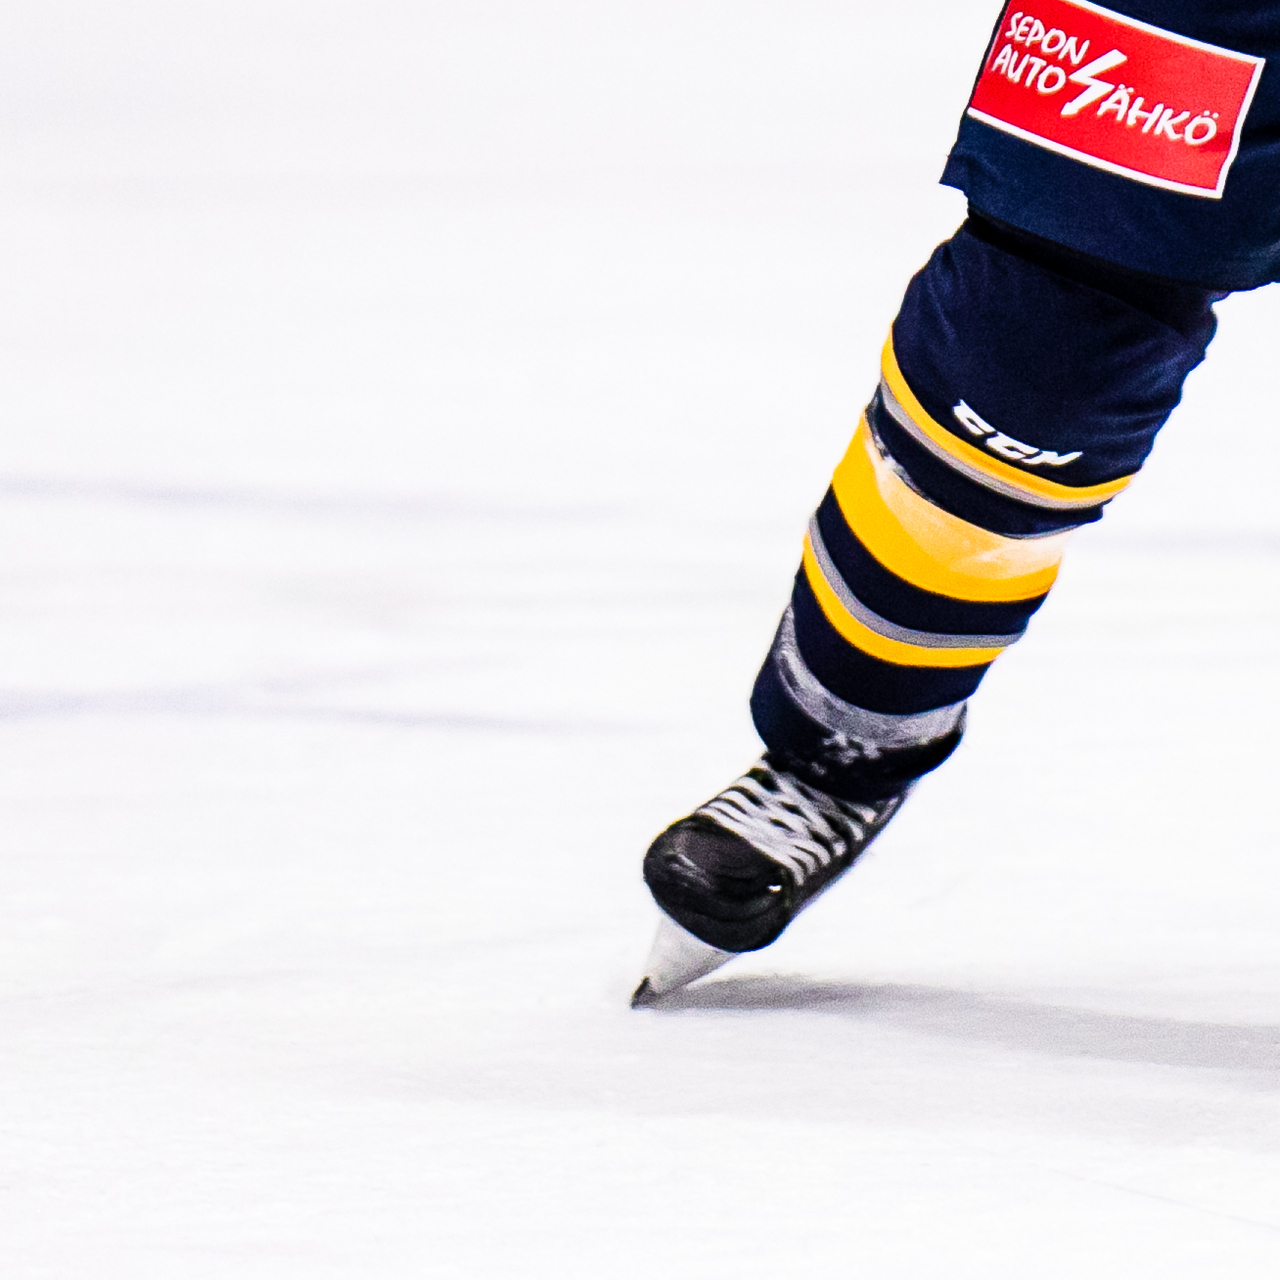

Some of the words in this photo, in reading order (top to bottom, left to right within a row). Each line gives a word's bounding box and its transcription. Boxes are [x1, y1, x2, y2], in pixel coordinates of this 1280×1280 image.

[1005, 11, 1090, 65] SEPON
[991, 44, 1066, 95] AUTO
[953, 398, 1083, 466] CCM
